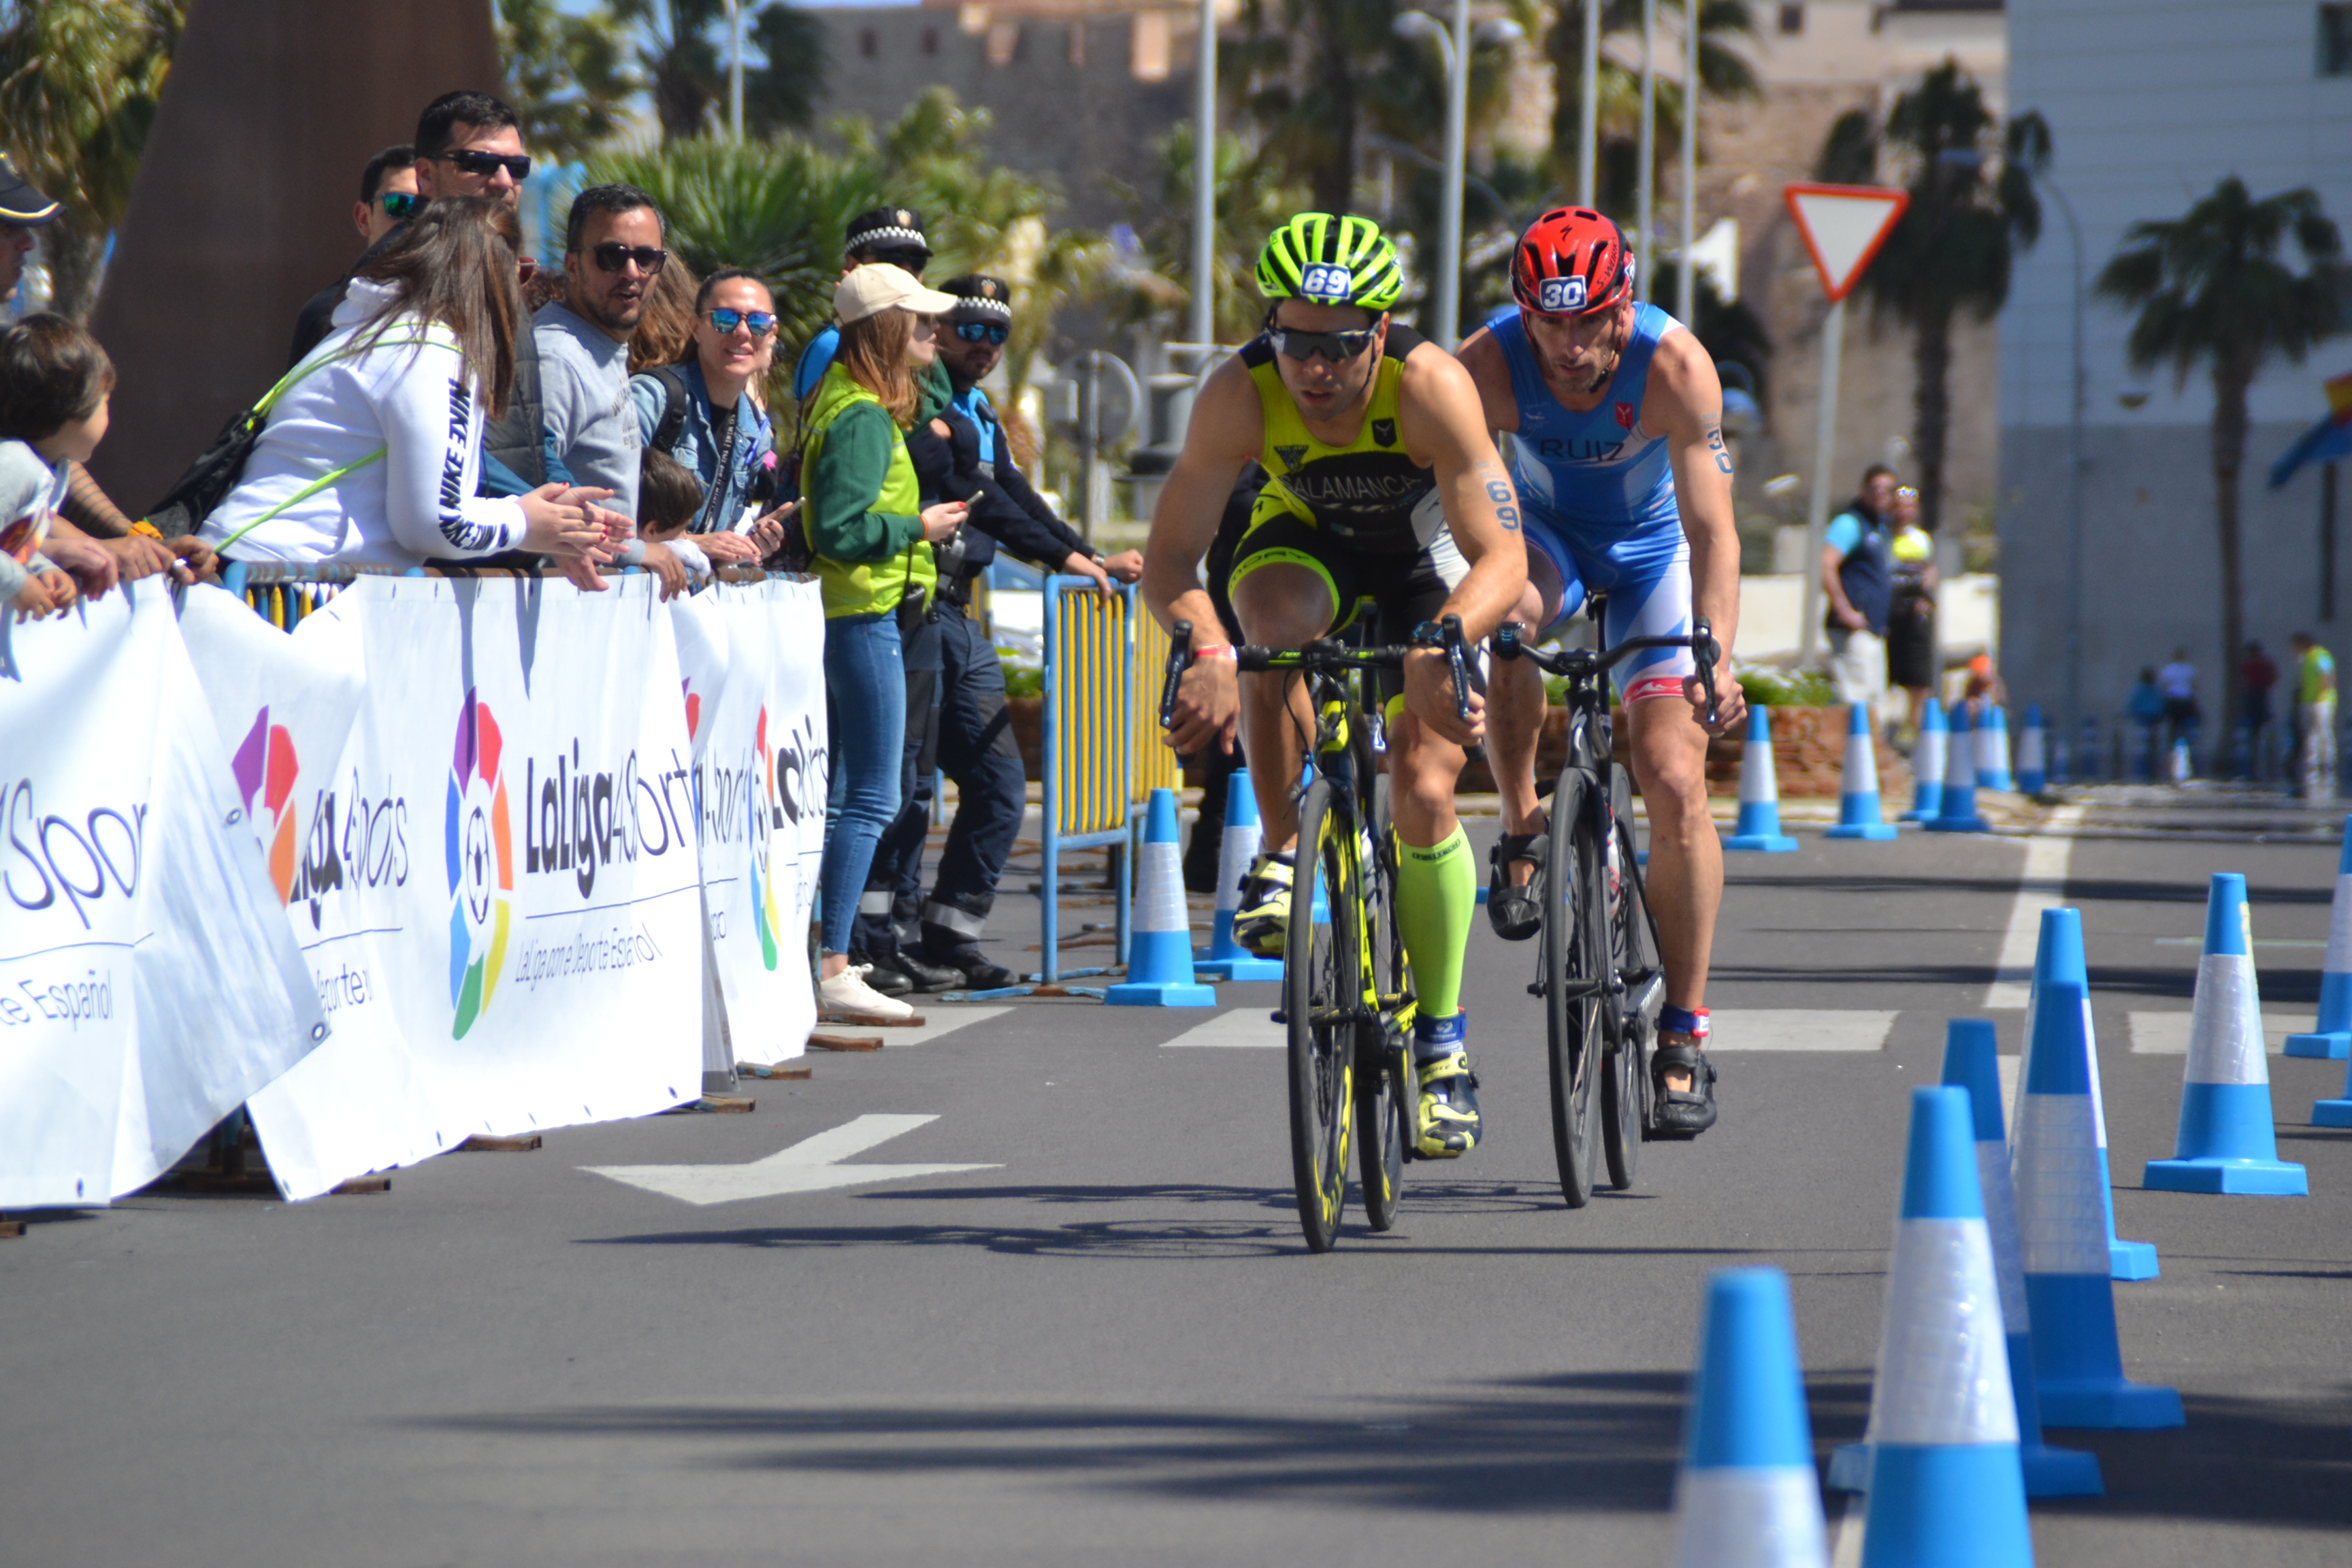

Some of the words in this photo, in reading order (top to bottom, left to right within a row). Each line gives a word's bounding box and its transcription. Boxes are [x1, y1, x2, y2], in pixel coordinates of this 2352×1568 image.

[1304, 268, 1348, 294] 69
[1544, 282, 1582, 306] 30
[448, 376, 471, 445] NIKE
[1539, 438, 1631, 462] RUIZ
[1707, 429, 1733, 474] 30
[439, 445, 465, 513] NIKE
[1280, 474, 1422, 499] SALAMANCA
[1486, 480, 1519, 531] 69
[18, 968, 114, 1032] Español
